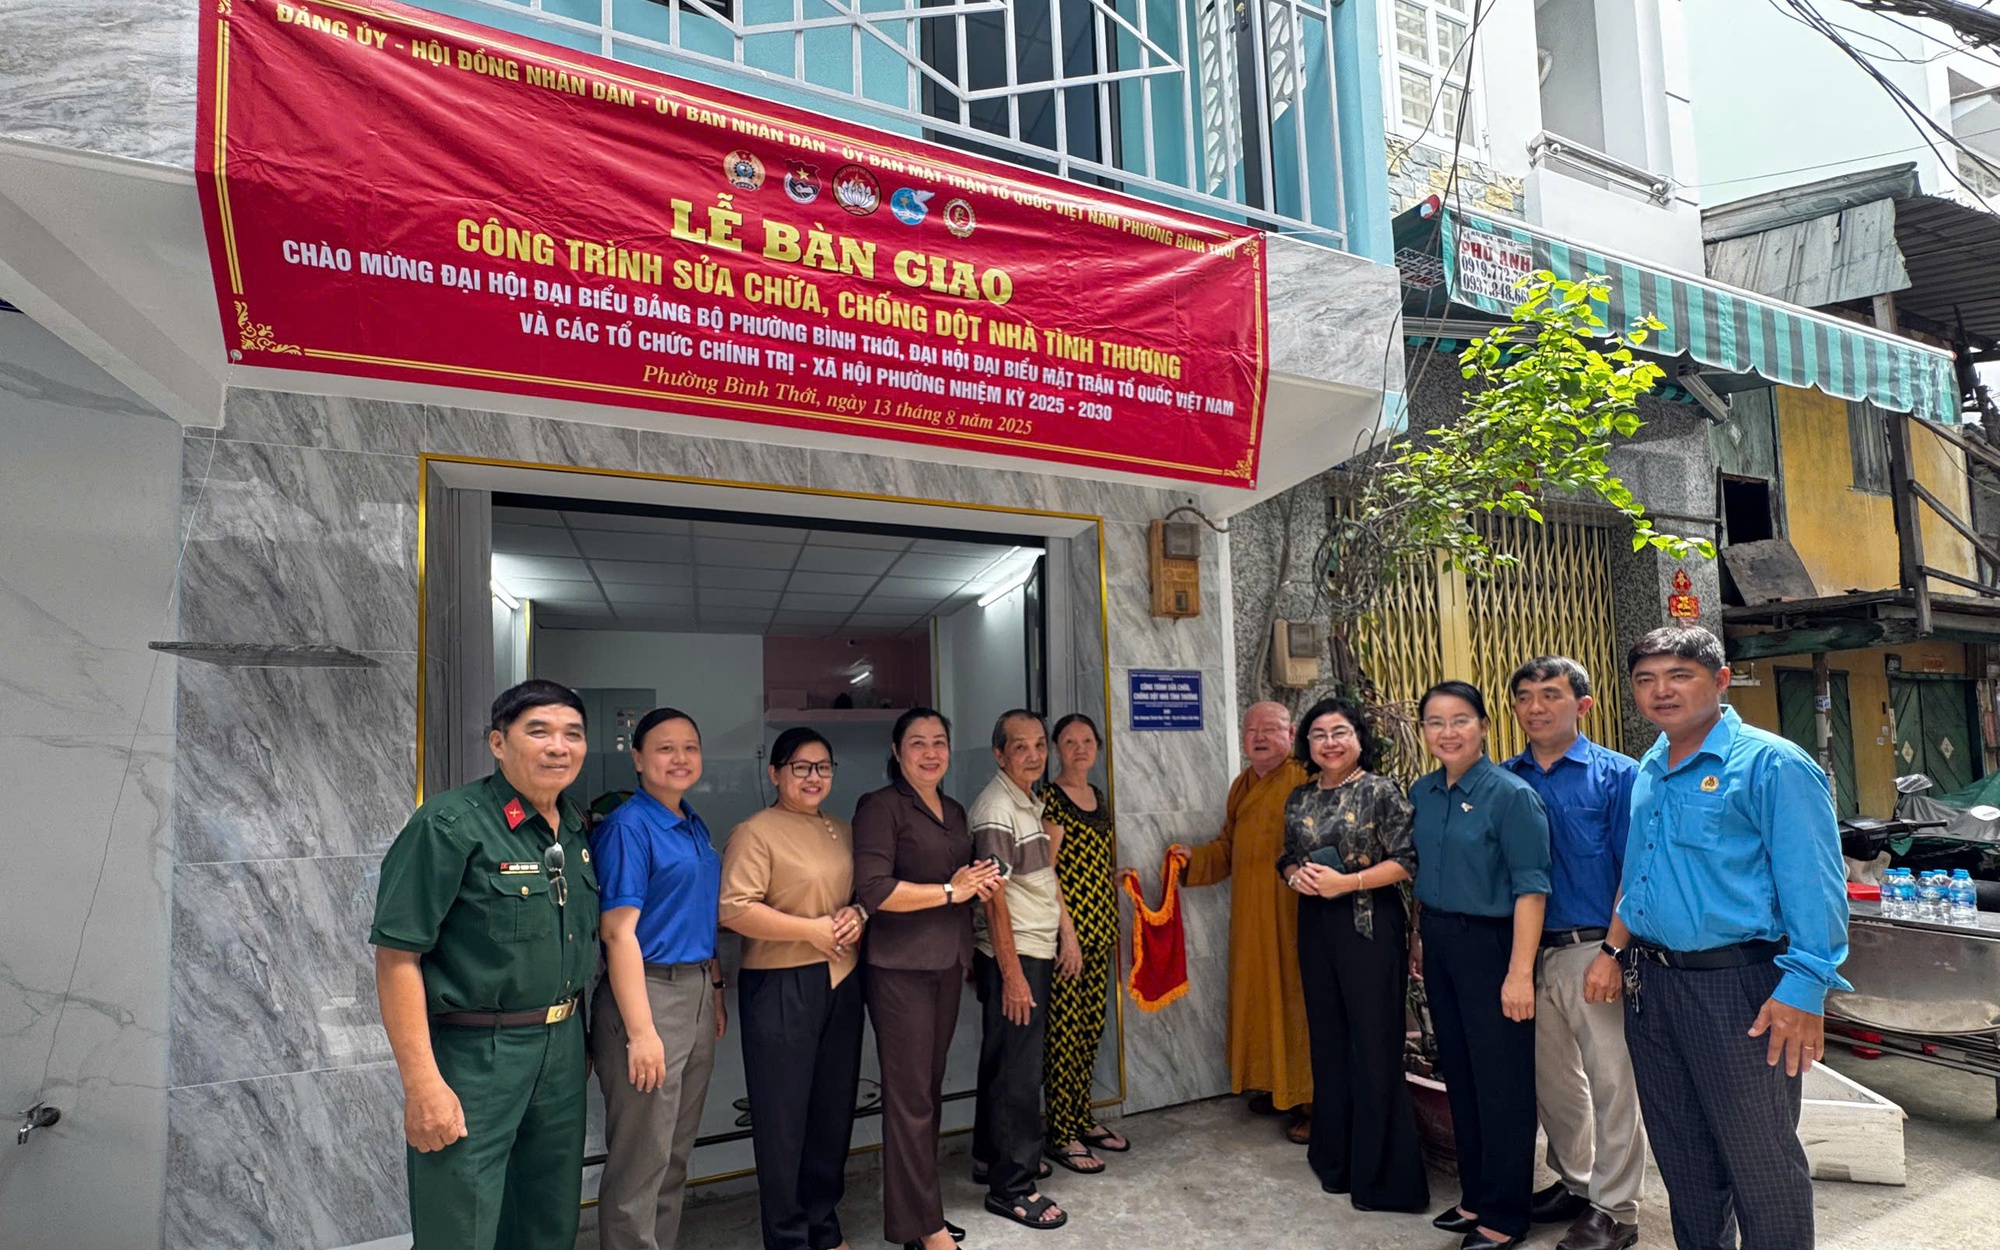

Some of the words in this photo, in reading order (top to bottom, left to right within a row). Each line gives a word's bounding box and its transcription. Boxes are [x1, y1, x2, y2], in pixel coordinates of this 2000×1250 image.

[276, 3, 348, 39] ĐẢNG
[356, 22, 387, 49] ỦY
[412, 39, 450, 67] HỘI
[457, 47, 519, 81] ĐỒNG
[526, 64, 586, 97] NHÂN
[592, 81, 635, 108] DÂN
[655, 94, 680, 117] ỦY
[686, 107, 726, 129] BAN
[731, 117, 784, 142] NHÂN
[789, 134, 826, 154] DÂN
[842, 145, 864, 163] ỦY
[869, 155, 904, 174] BAN
[947, 174, 987, 196] TRẬN
[1087, 210, 1119, 230] NAM
[1122, 217, 1173, 246] PHƯỜNG
[1175, 232, 1206, 254] BÌNH
[457, 217, 554, 266] CÔNG
[565, 239, 662, 286] TRÌNH
[673, 254, 735, 298] SỬA
[744, 272, 829, 318] CHỮA,
[838, 290, 928, 333] CHỐNG
[935, 307, 982, 346] DỘT
[988, 320, 1038, 353] NHÀ
[1043, 328, 1093, 364] TÌNH
[1100, 341, 1181, 380] THƯƠNG
[670, 192, 743, 252] LỄ
[762, 219, 876, 279] BÀN
[893, 250, 1014, 306] GIAO
[1499, 250, 1531, 273] ANH
[282, 239, 351, 272] CHÀO
[359, 250, 434, 284] MỪNG
[441, 264, 480, 294] ĐẠI
[488, 271, 527, 301] HỘI
[534, 279, 571, 307] ĐẠI
[579, 284, 627, 313] BIỂU
[634, 293, 691, 324] ĐẢNG
[697, 306, 723, 334] BỘ
[729, 313, 808, 344] PHƯỜNG
[813, 325, 856, 351] BÌNH
[861, 335, 905, 362] THỚI,
[909, 343, 937, 365] ĐẠI
[942, 348, 969, 372] HỘI
[973, 354, 999, 378] ĐẠI
[1004, 358, 1038, 382] BIỂU
[1042, 366, 1074, 391] MẶT
[1077, 373, 1114, 397] TRẬN
[1117, 377, 1135, 399] TỔ
[1137, 382, 1173, 406] QUỐC
[1175, 390, 1203, 414] VIỆT
[1205, 397, 1234, 417] NAM
[519, 310, 549, 336] VÀ
[555, 316, 599, 343] CÁC
[606, 320, 633, 348] TỔ
[638, 330, 693, 357] CHỨC
[699, 339, 760, 367] CHÍNH
[765, 350, 794, 376] TRỊ
[813, 356, 837, 378] XÃ
[842, 361, 872, 386] HỘI
[877, 367, 945, 395] PHƯỜNG
[949, 379, 1001, 405] NHIỆM
[1005, 386, 1028, 408] KỲ
[1029, 392, 1065, 414] 2025
[1078, 401, 1112, 422] 2030
[642, 364, 719, 396] Phường
[723, 376, 769, 398] Bình
[776, 383, 821, 407] Thới,
[827, 394, 867, 415] ngày
[872, 398, 891, 416] 13
[895, 403, 942, 426] tháng
[945, 409, 956, 426] 8
[959, 413, 993, 430] năm
[997, 416, 1032, 435] 2025
